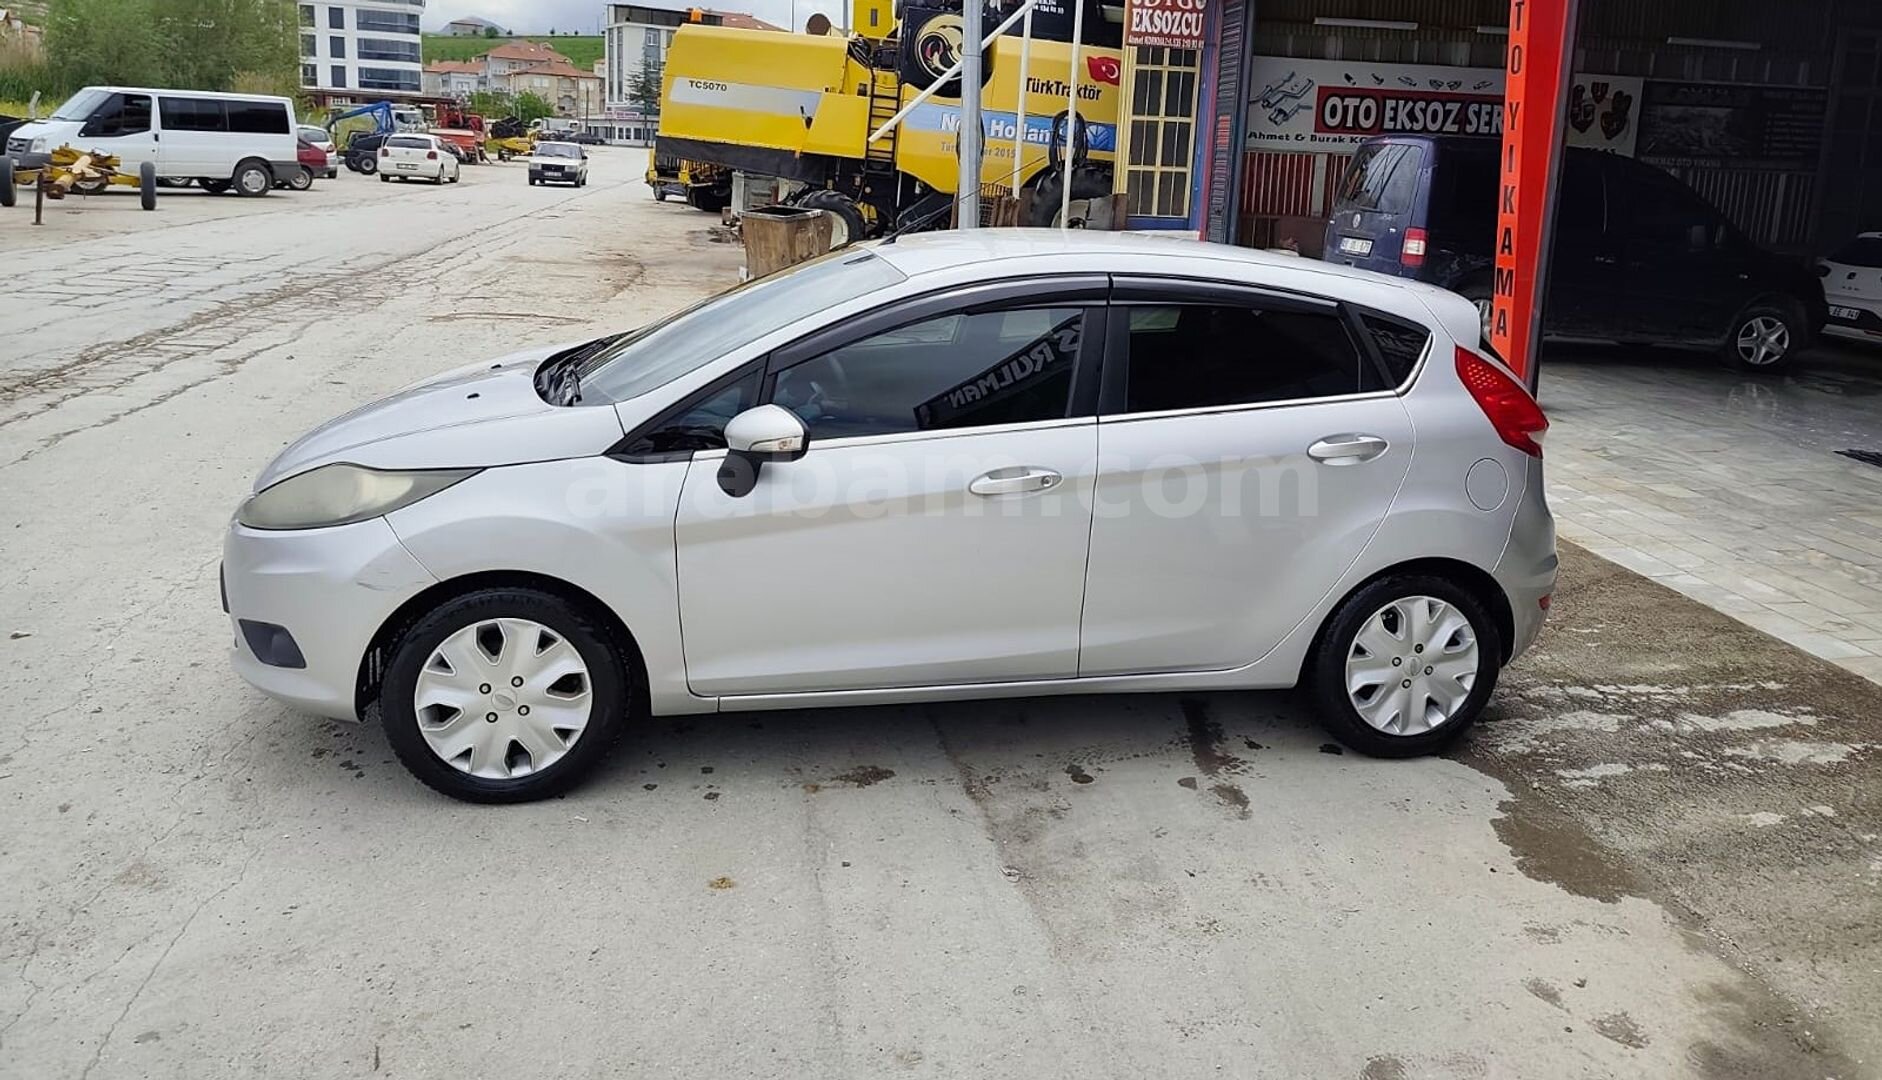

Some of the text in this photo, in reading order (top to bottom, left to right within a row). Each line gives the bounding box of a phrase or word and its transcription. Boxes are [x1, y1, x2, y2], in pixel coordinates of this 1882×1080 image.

[1131, 8, 1204, 36] EKSOZCU
[689, 80, 727, 91] TC5070
[1324, 96, 1377, 129] OTO
[1383, 99, 1462, 133] EKSOZ
[1248, 131, 1290, 141] Ahmet
[1294, 133, 1306, 142] &
[1310, 134, 1346, 143] Burak
[1495, 101, 1520, 338] YIKAMA
